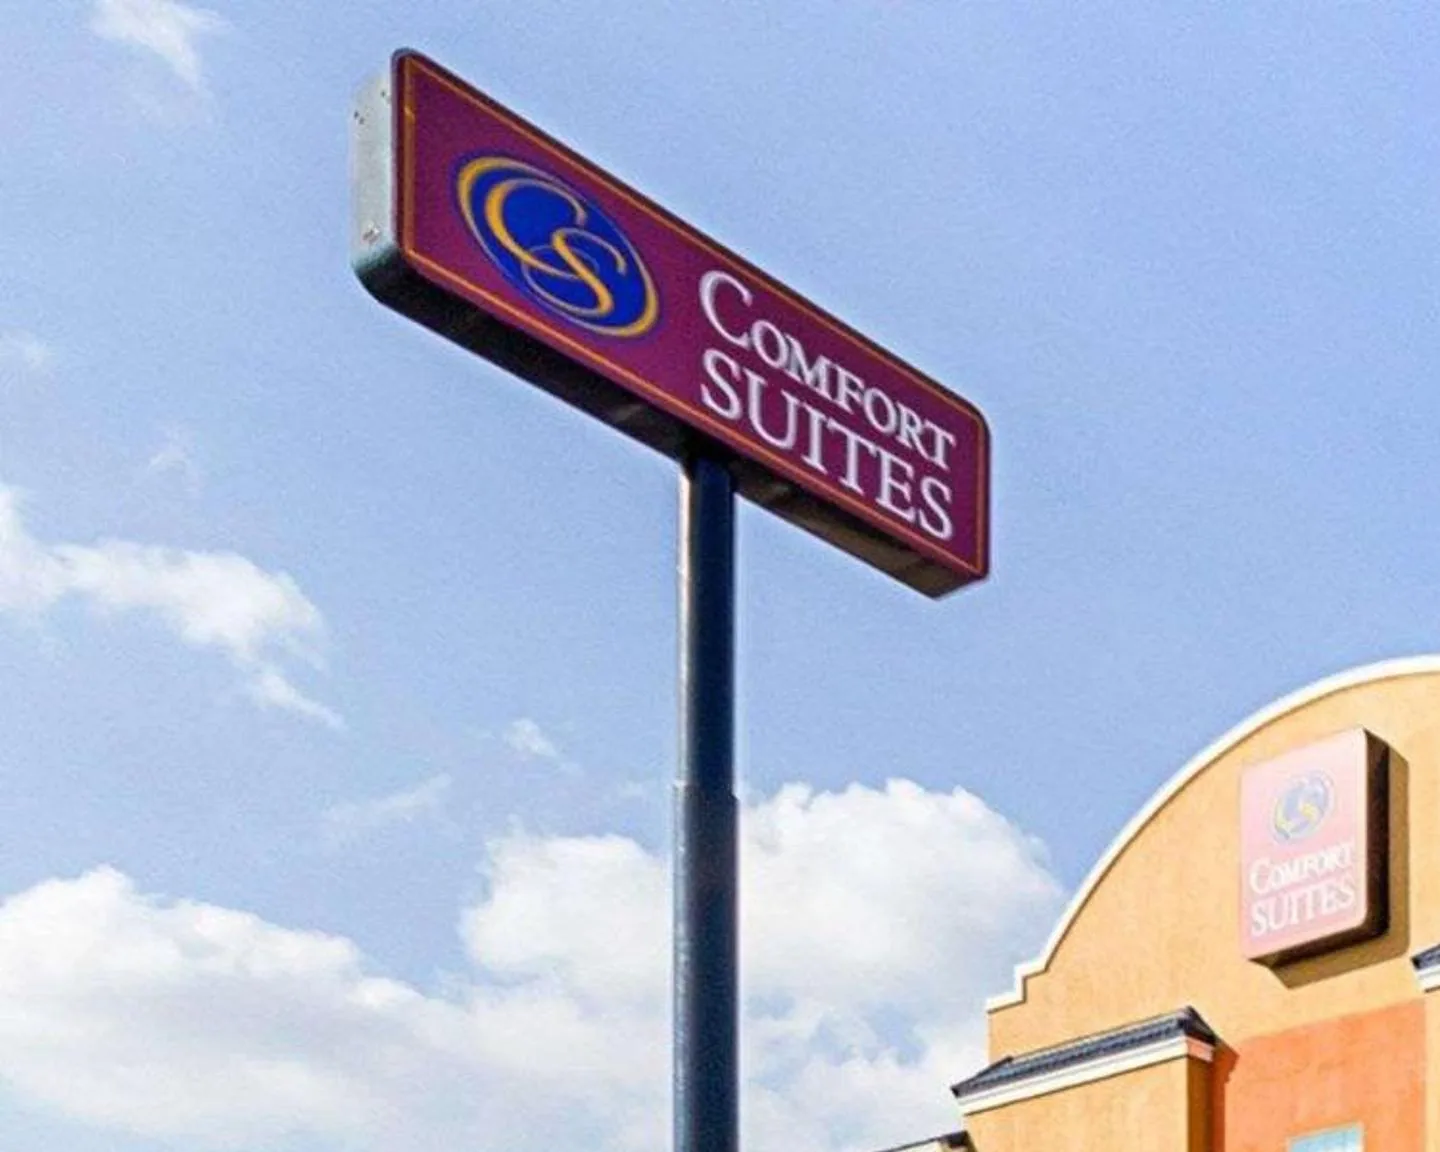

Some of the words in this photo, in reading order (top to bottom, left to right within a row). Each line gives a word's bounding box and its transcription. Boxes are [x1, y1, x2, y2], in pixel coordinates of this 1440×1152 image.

[700, 269, 954, 471] COMFORT
[700, 349, 953, 540] SUITES
[1252, 874, 1355, 935] SUITES
